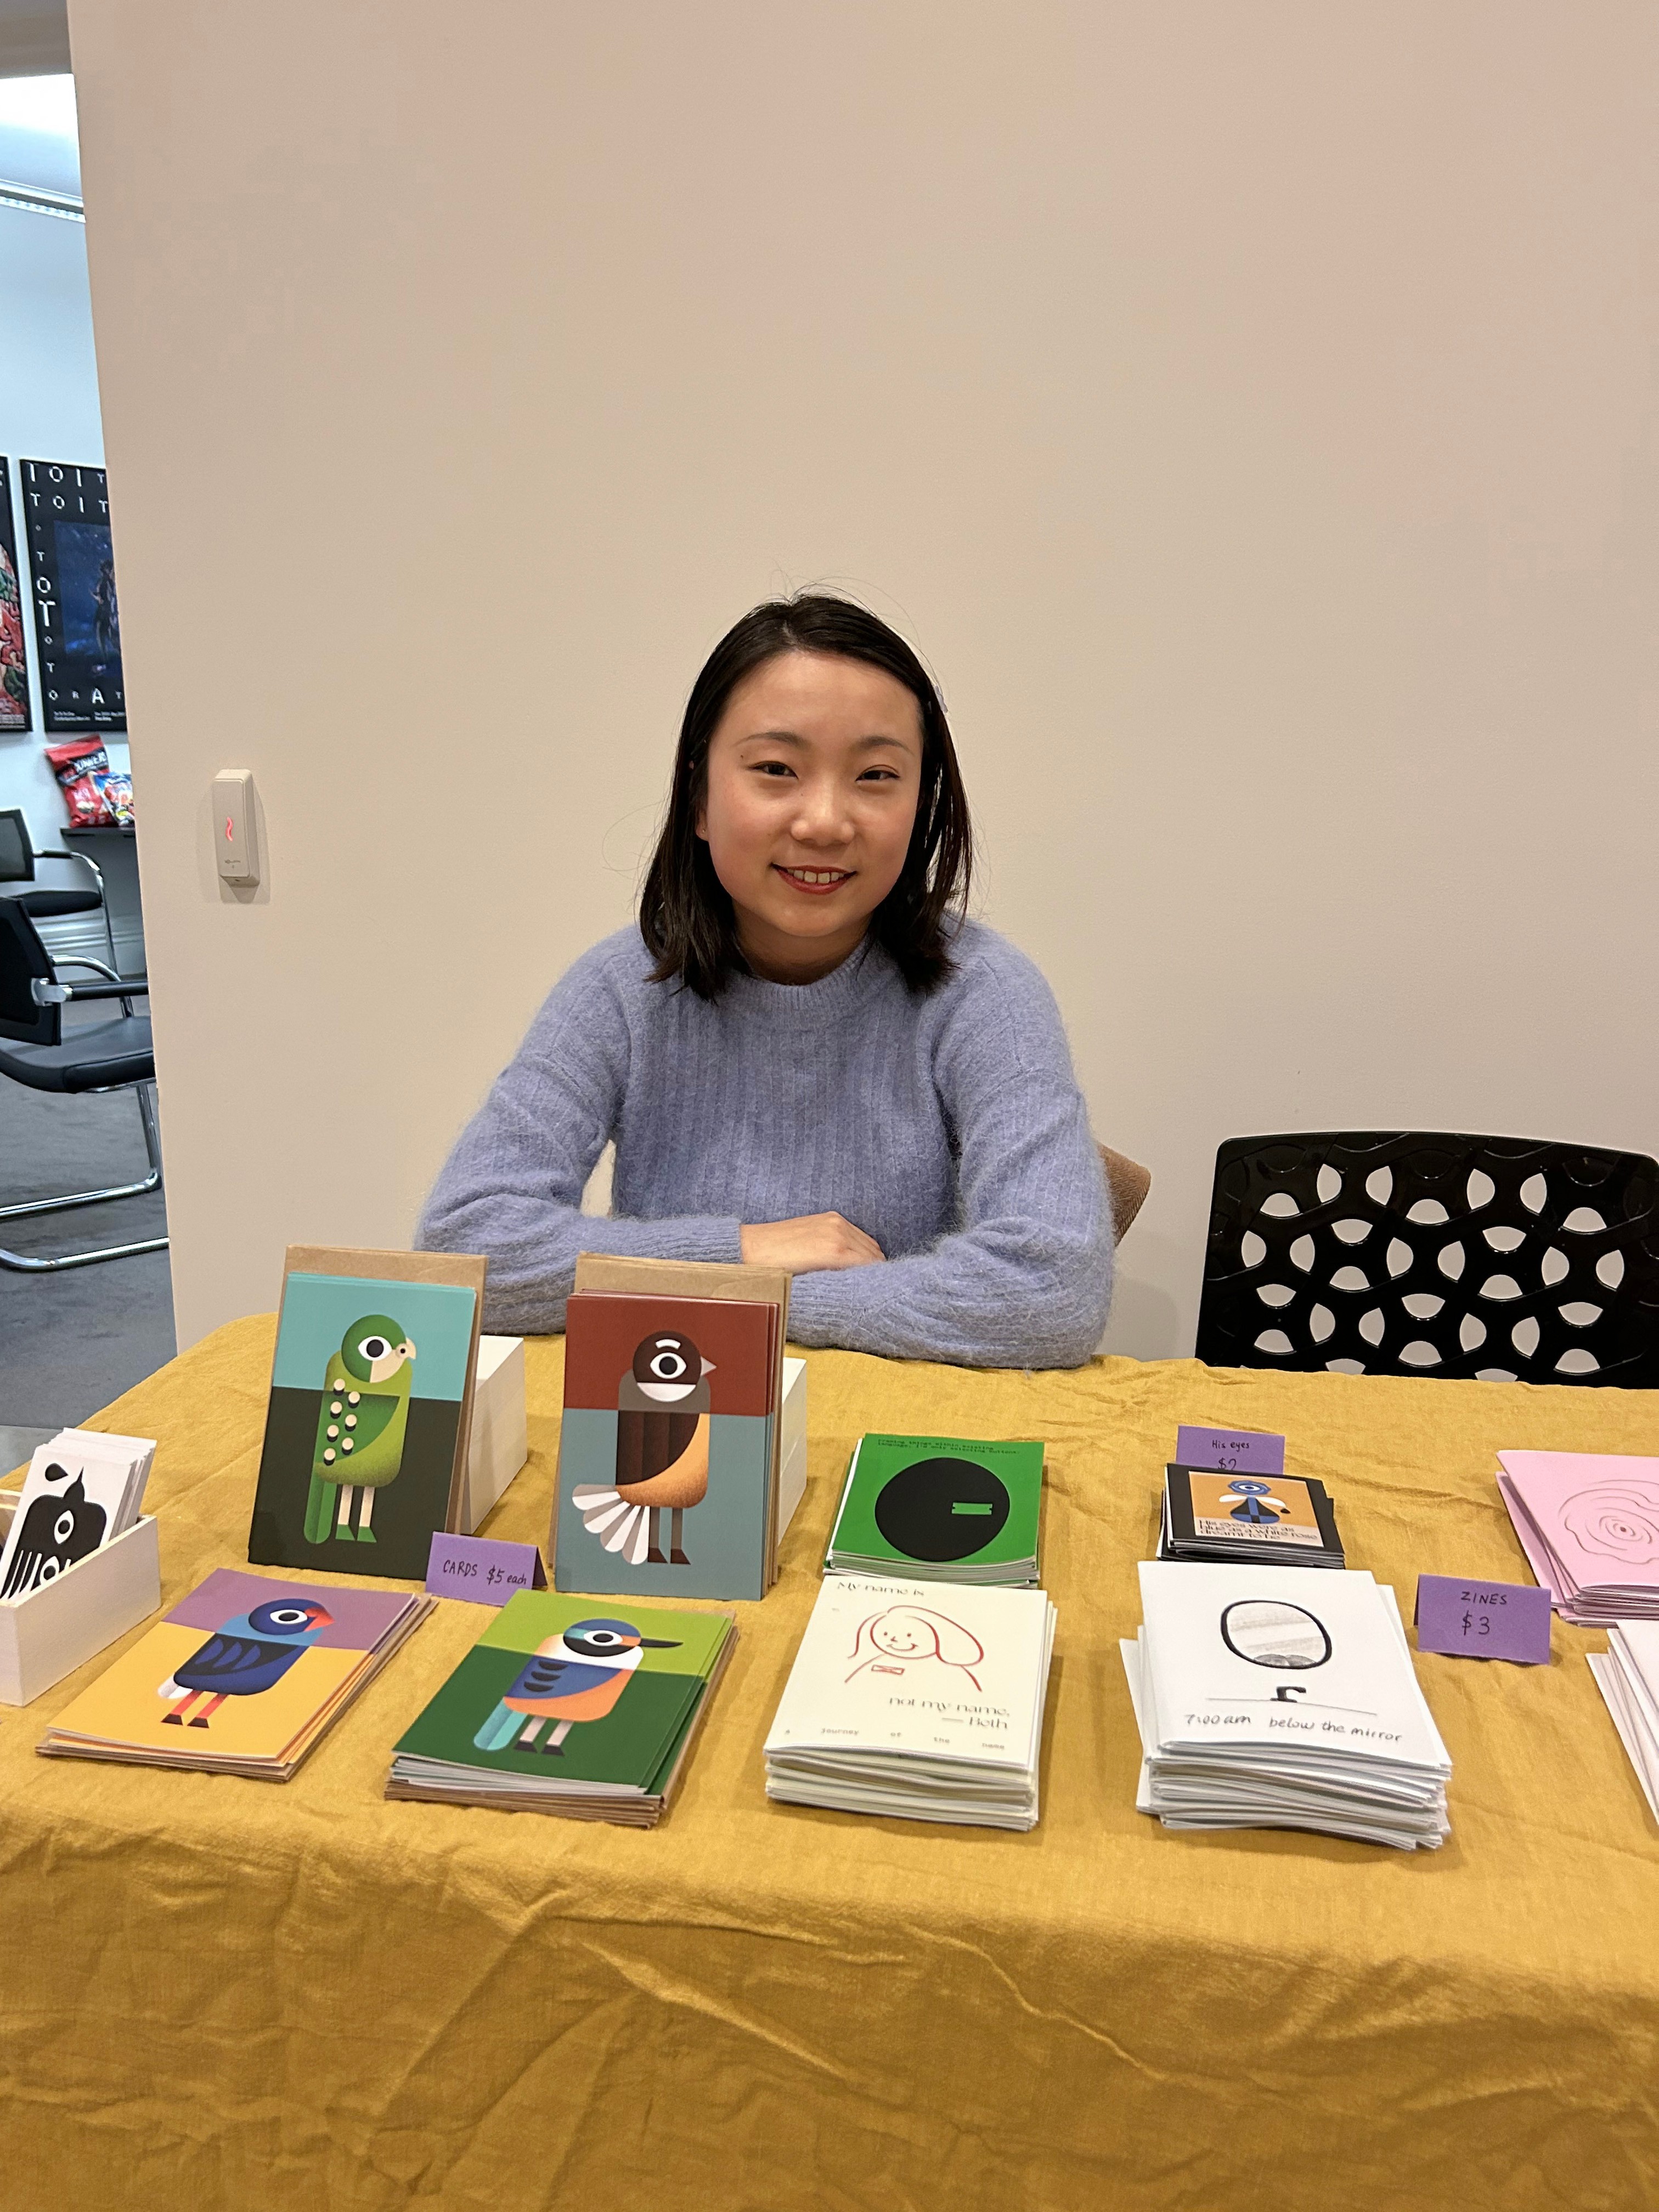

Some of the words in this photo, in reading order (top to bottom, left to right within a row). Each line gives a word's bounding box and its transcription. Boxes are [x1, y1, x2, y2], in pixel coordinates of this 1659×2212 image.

[1212, 1439, 1226, 1449] His
[1230, 1441, 1250, 1453] eyes
[443, 1559, 478, 1577] CARDS
[486, 1564, 505, 1585] $5
[506, 1573, 527, 1585] each
[837, 1581, 861, 1592] My
[865, 1584, 909, 1595] name
[913, 1588, 924, 1596] is
[1460, 1591, 1507, 1605] ZINES
[889, 1697, 915, 1707] not
[922, 1700, 952, 1712] my
[1269, 1716, 1315, 1730] below
[1321, 1720, 1346, 1733] the
[1351, 1728, 1403, 1742] mirror
[981, 1742, 1005, 1751] name
